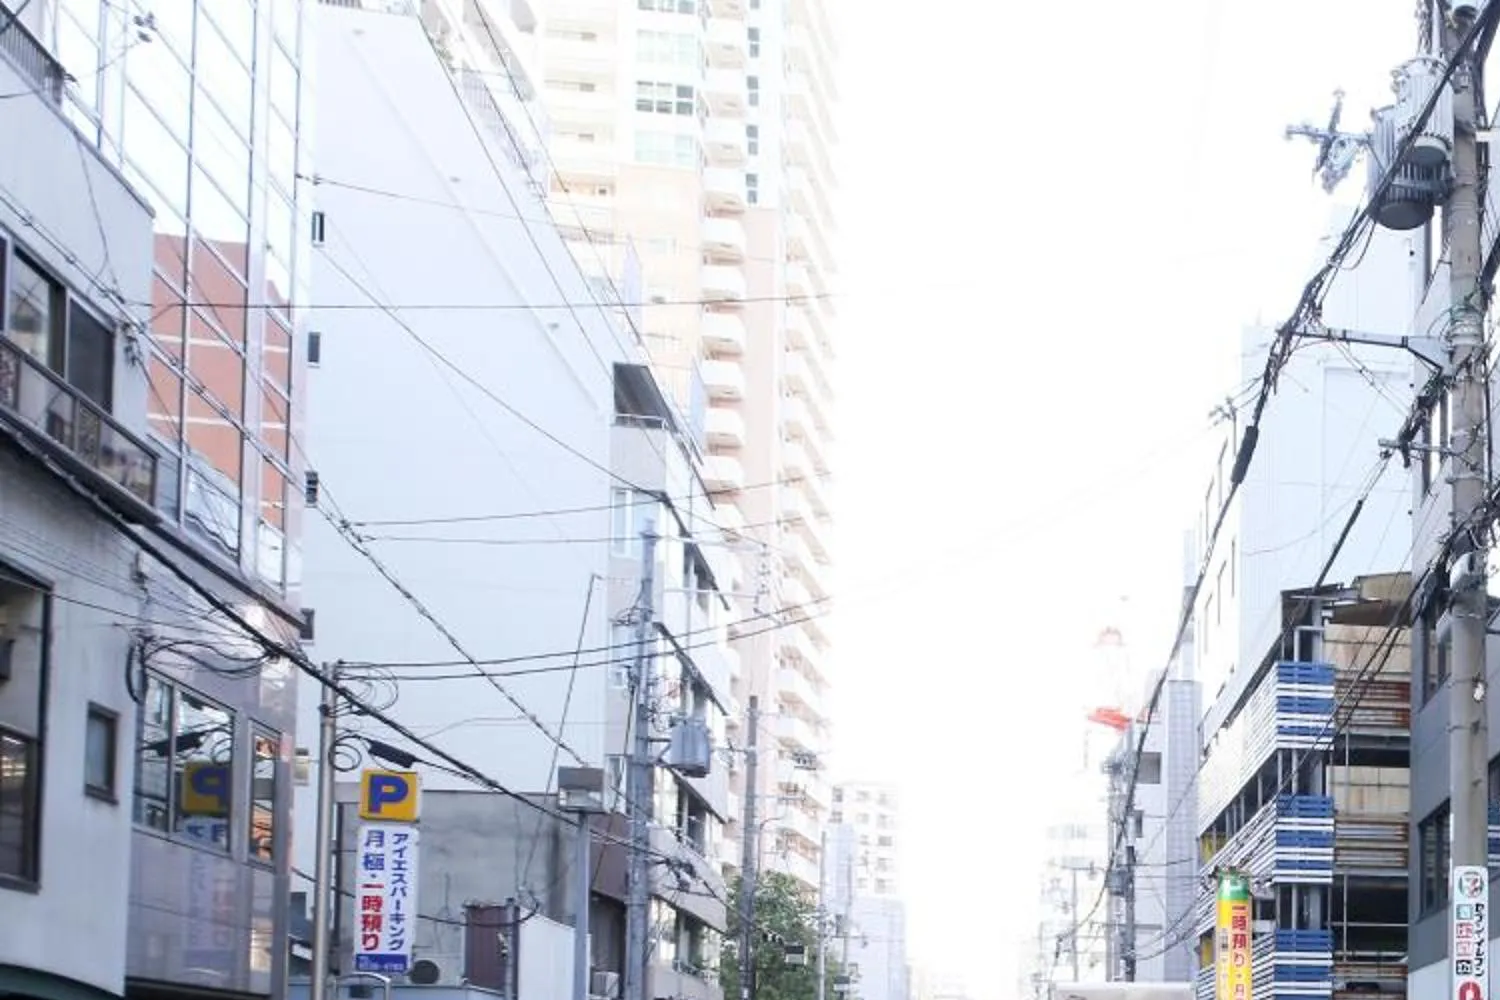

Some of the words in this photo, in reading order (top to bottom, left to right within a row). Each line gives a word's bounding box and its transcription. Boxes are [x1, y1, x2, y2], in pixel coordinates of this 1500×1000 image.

[368, 774, 409, 814] P
[387, 833, 409, 951] アイエスパーキング
